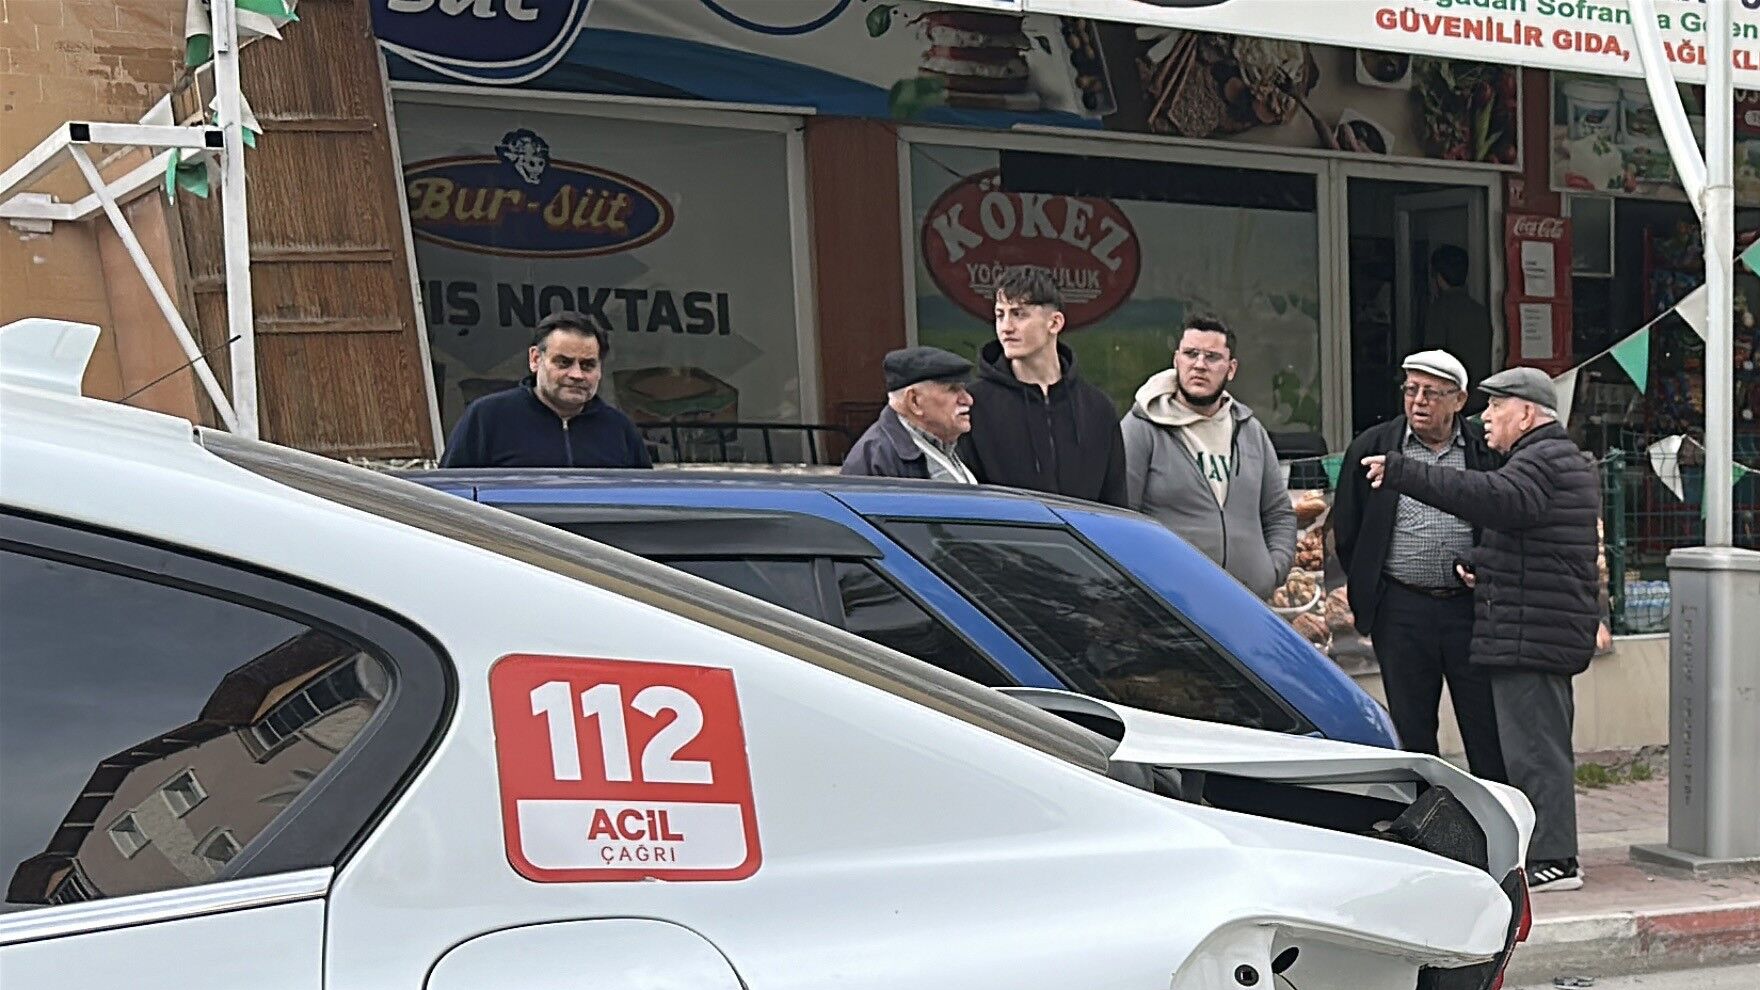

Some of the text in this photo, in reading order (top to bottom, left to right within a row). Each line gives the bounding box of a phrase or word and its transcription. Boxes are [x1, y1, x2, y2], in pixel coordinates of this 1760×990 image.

[1375, 7, 1543, 48] GÜVENİLİR
[1552, 29, 1631, 61] GIDA,
[1537, 0, 1671, 29] Sofrana
[1681, 12, 1757, 39] Gen
[932, 175, 1130, 272] KÖKEZ
[496, 283, 731, 336] NOKTASI
[529, 681, 714, 784] 112
[587, 808, 684, 842] ACİL
[600, 844, 676, 864] ÇAĞRI
